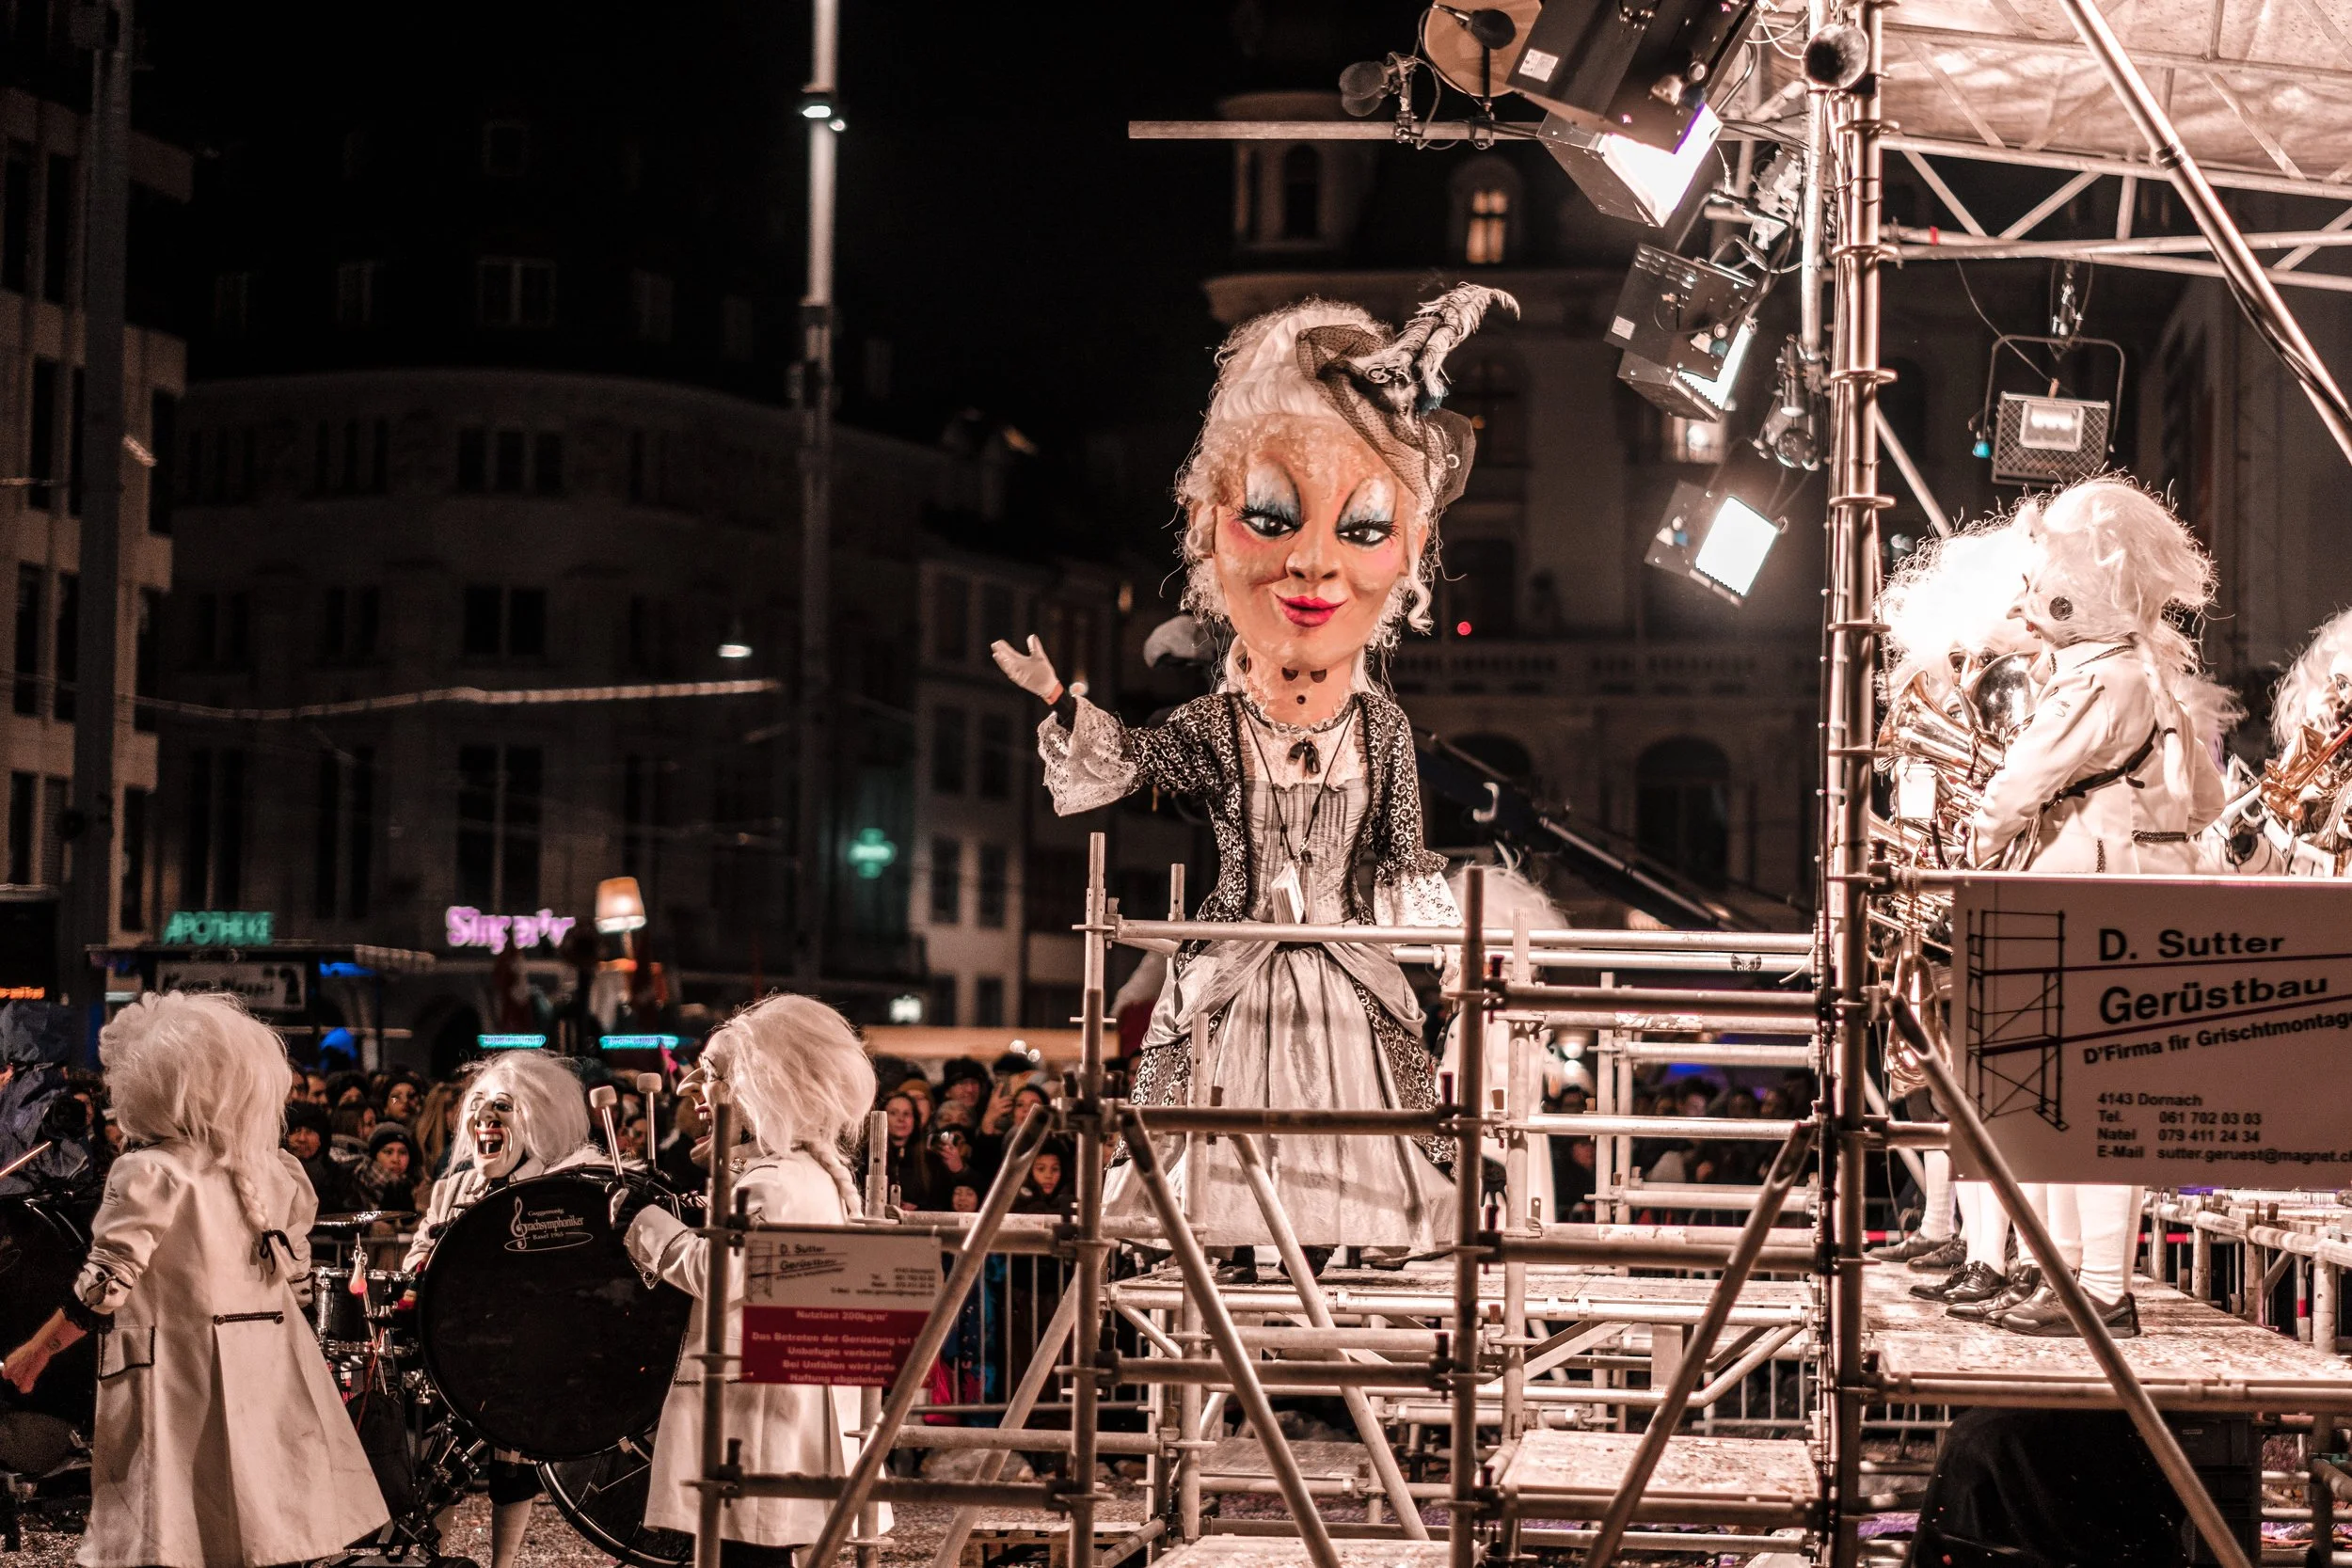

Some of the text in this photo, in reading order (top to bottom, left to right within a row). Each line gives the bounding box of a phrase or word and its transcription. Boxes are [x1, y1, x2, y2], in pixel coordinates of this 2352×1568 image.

[2099, 928, 2285, 961] D. Sutter
[2100, 976, 2328, 1026] Gerüstbau
[2084, 1037, 2163, 1065] D'Firma
[2169, 1034, 2191, 1052] fir
[2097, 1092, 2203, 1106] 4143 Dornach
[2098, 1110, 2262, 1126] Tel. 061 702 03 03
[2097, 1128, 2261, 1143] Natel 079 411 24 34
[2097, 1146, 2144, 1159] E-Mail
[796, 1310, 839, 1321] Nutzlast
[752, 1332, 771, 1341] Das
[774, 1332, 820, 1343] Betreten
[822, 1334, 839, 1343] der
[842, 1334, 895, 1347] Gerüstung
[787, 1346, 841, 1357] Unbefugte
[783, 1359, 896, 1372] Bei Unfällen wird jede
[790, 1373, 831, 1385] Haftung
